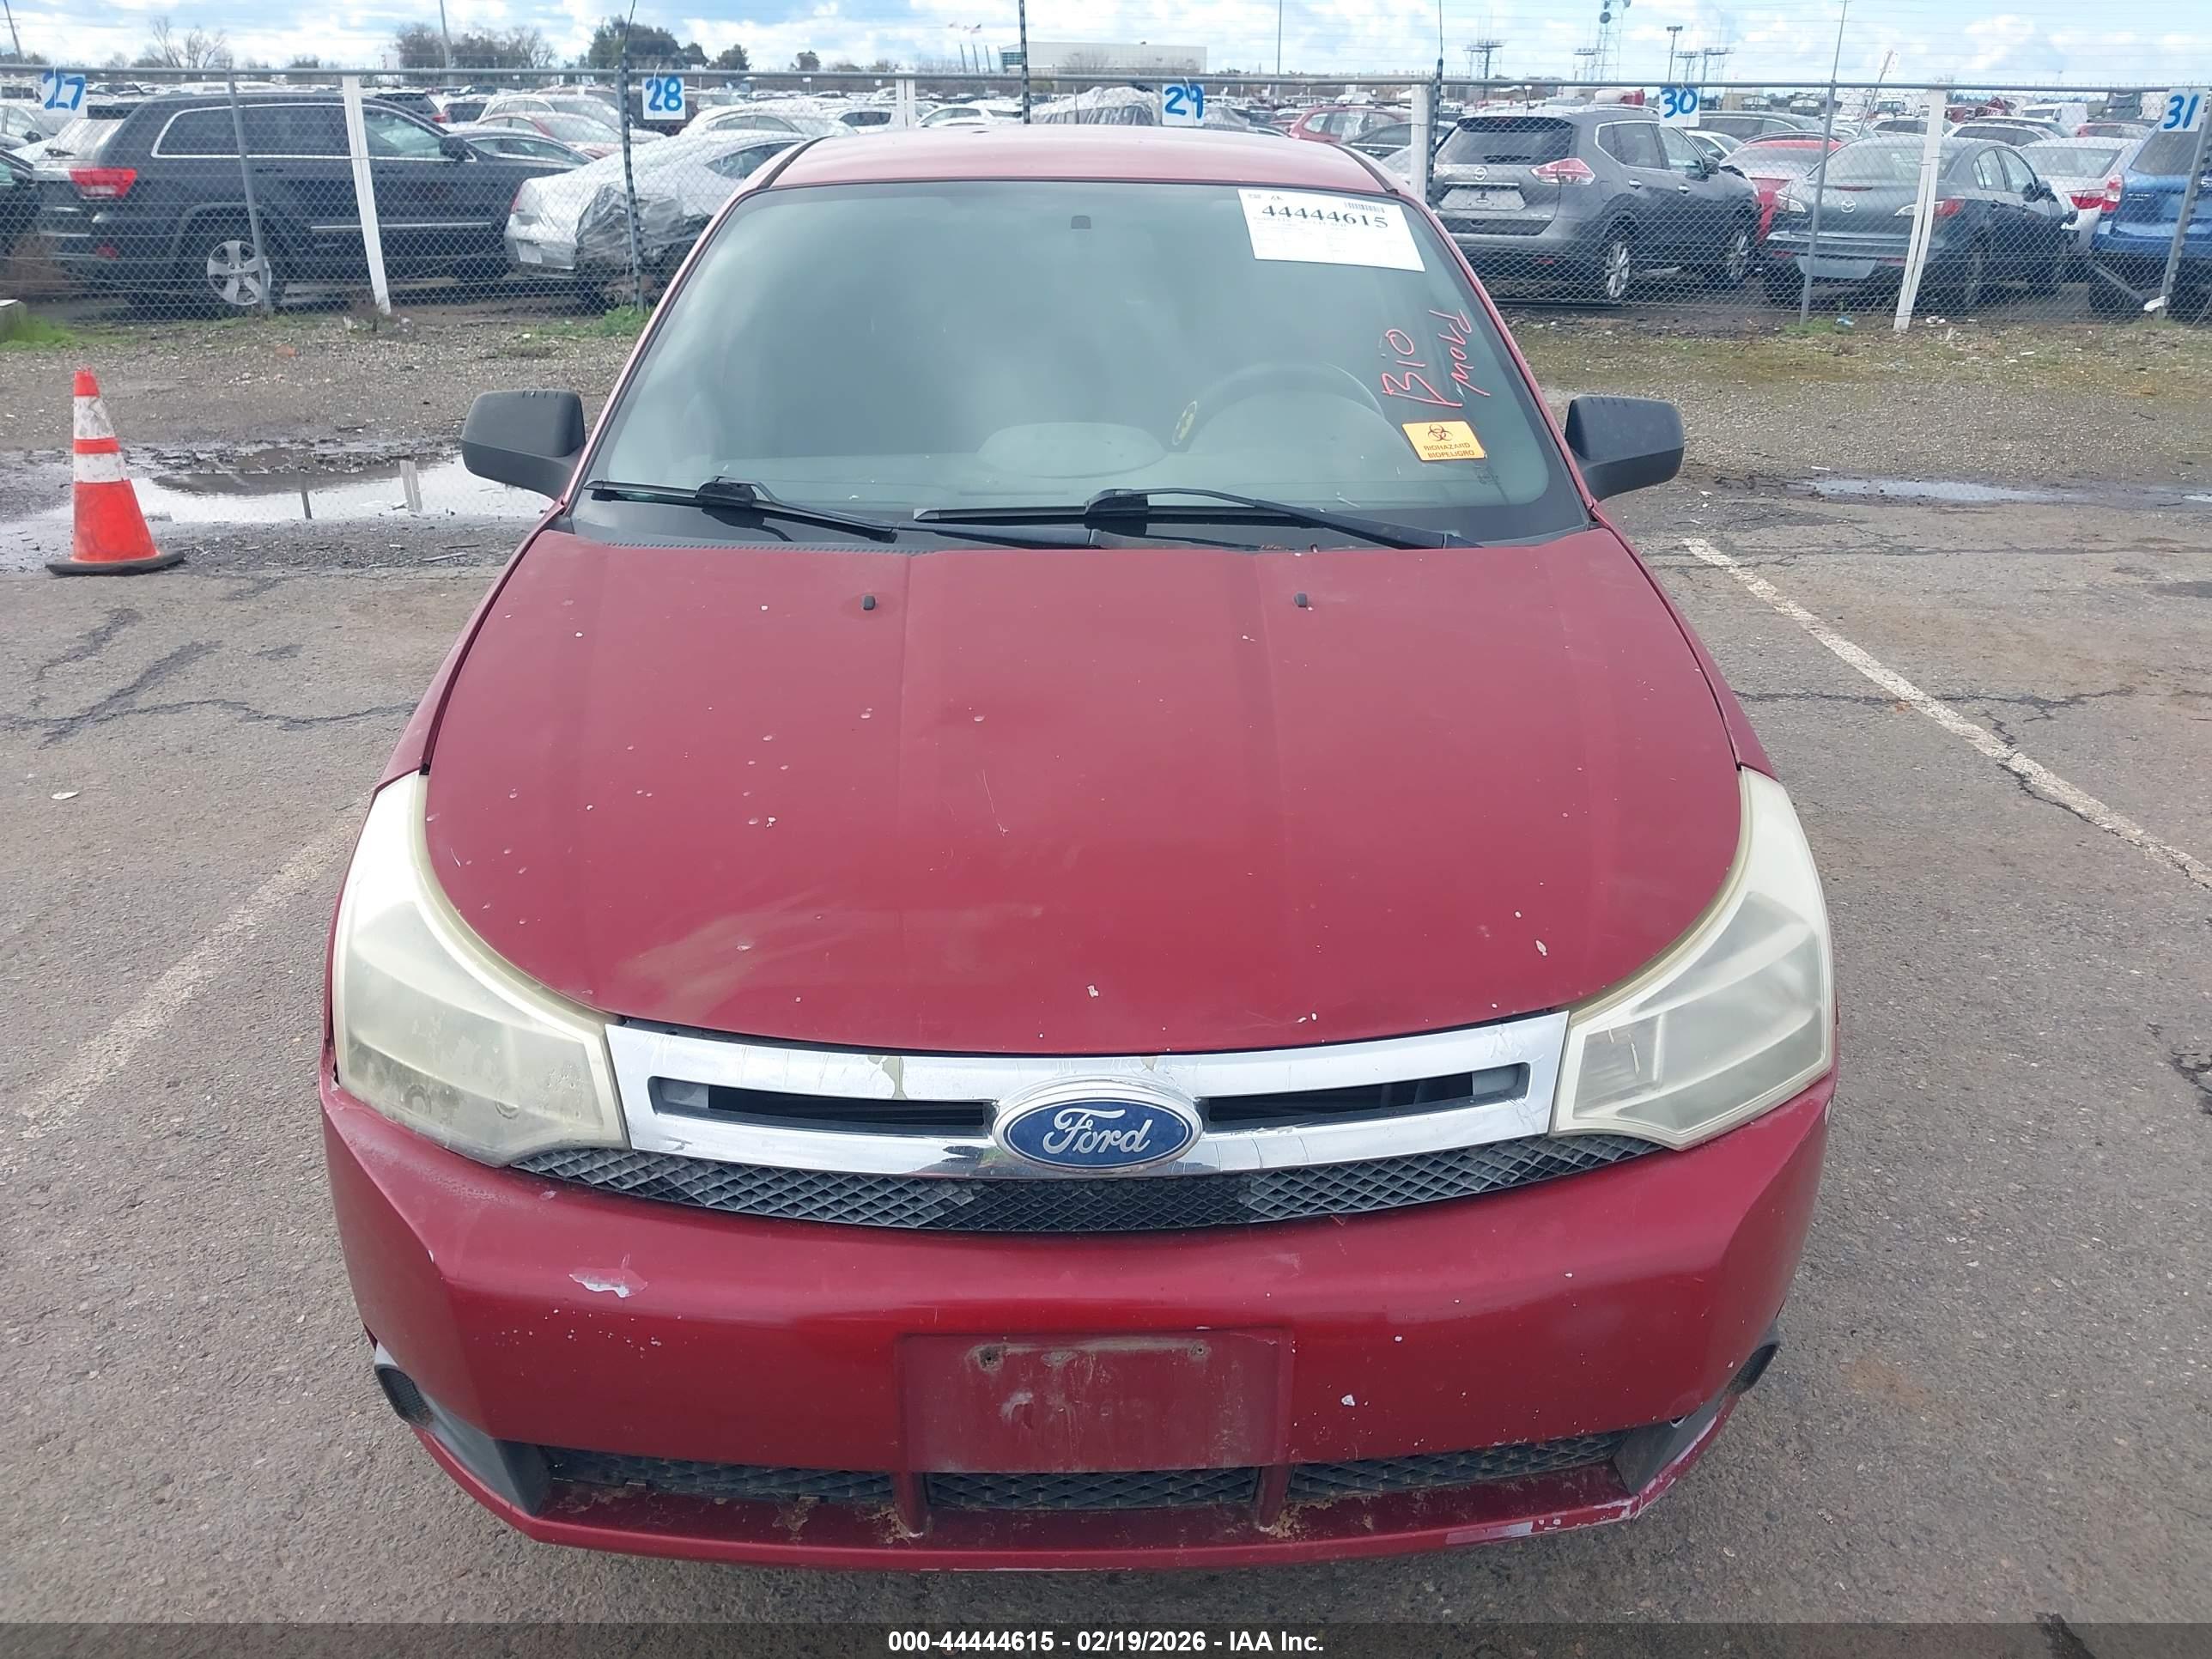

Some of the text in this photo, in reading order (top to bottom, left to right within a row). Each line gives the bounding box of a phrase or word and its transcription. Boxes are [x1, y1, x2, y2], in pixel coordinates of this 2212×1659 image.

[42, 70, 85, 111] 27
[646, 75, 683, 112] 28
[1164, 82, 1203, 118] 29
[1661, 88, 1698, 118] 30
[2163, 94, 2199, 129] 31
[1261, 204, 1389, 228] 44444615
[1423, 442, 1471, 451] BIOHAZARD
[1427, 449, 1475, 458] BIOPELIGRO
[1042, 1108, 1152, 1154] Ford
